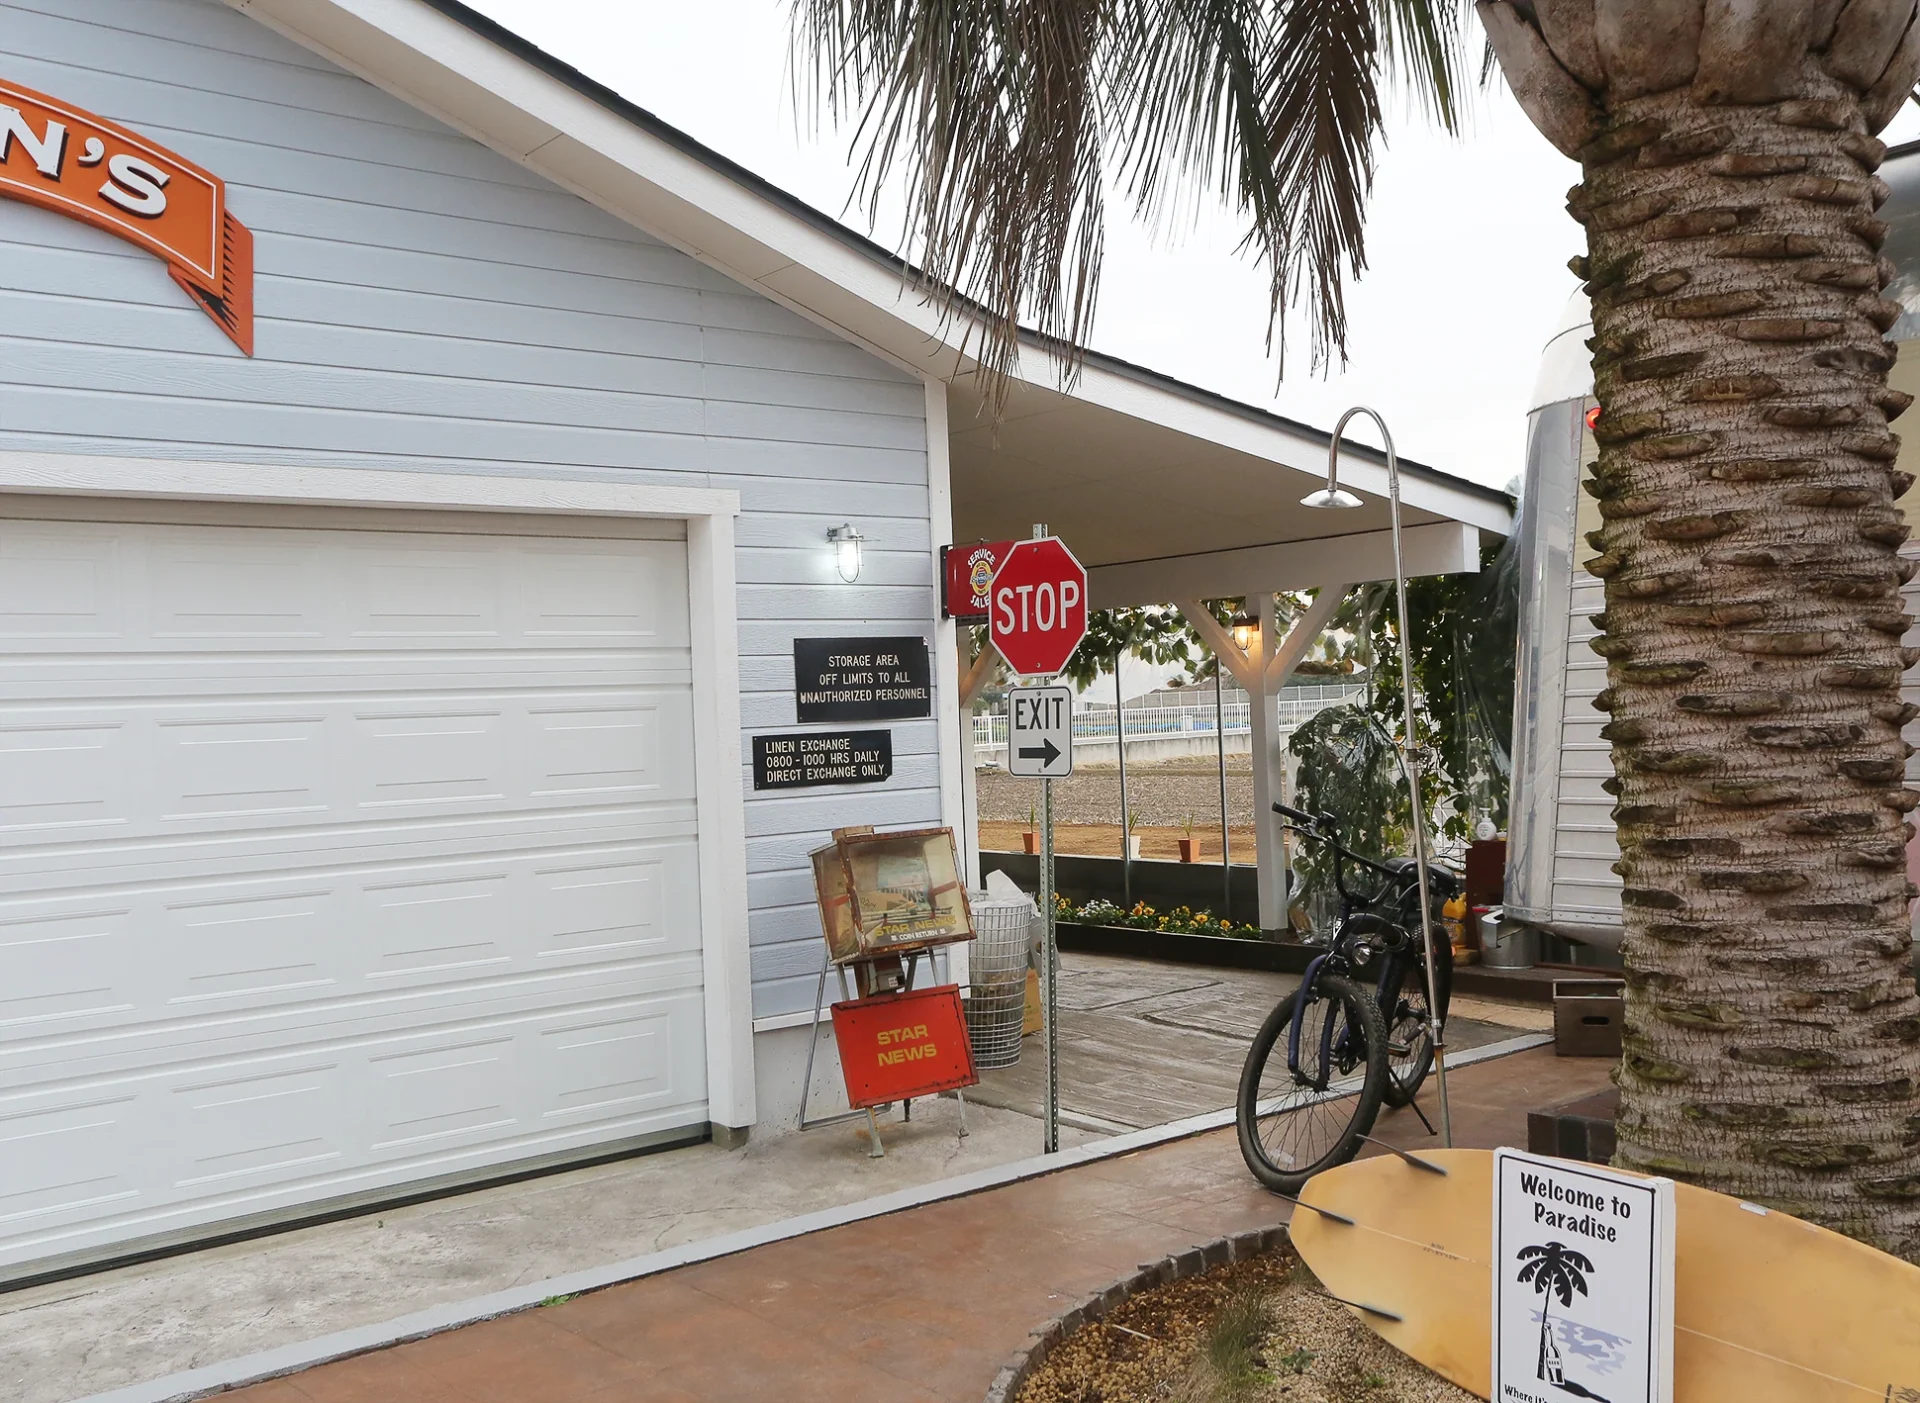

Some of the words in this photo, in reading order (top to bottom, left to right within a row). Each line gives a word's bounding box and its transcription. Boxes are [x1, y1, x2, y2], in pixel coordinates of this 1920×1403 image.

[967, 548, 996, 568] SERVICE
[996, 580, 1080, 635] STOP
[828, 655, 871, 667] STORAGE
[875, 654, 900, 666] AREA
[819, 674, 837, 685] OFF
[842, 673, 874, 685] LIMITS
[878, 672, 890, 683] TO
[894, 671, 911, 683] ALL
[800, 689, 872, 704] UNAUTHORIZED
[875, 687, 928, 701] PERSONNEL
[1015, 697, 1064, 730] EXIT
[765, 741, 795, 754] LINEN
[800, 738, 850, 751] EXCHANGE
[830, 752, 850, 764] HRS
[854, 750, 880, 763] DAILY
[767, 769, 801, 783] DIRECT
[806, 766, 857, 780] EXCHANGE
[875, 924, 910, 937] STAR
[914, 914, 957, 930] NEWS
[899, 932, 915, 941] COIN
[915, 929, 938, 939] RETURN
[877, 1024, 929, 1045] STAR
[877, 1043, 937, 1067] NEWS
[1520, 1171, 1605, 1212] Welcome
[1611, 1195, 1631, 1219] to
[1534, 1201, 1617, 1243] Paradise
[1504, 1383, 1533, 1403] Where
